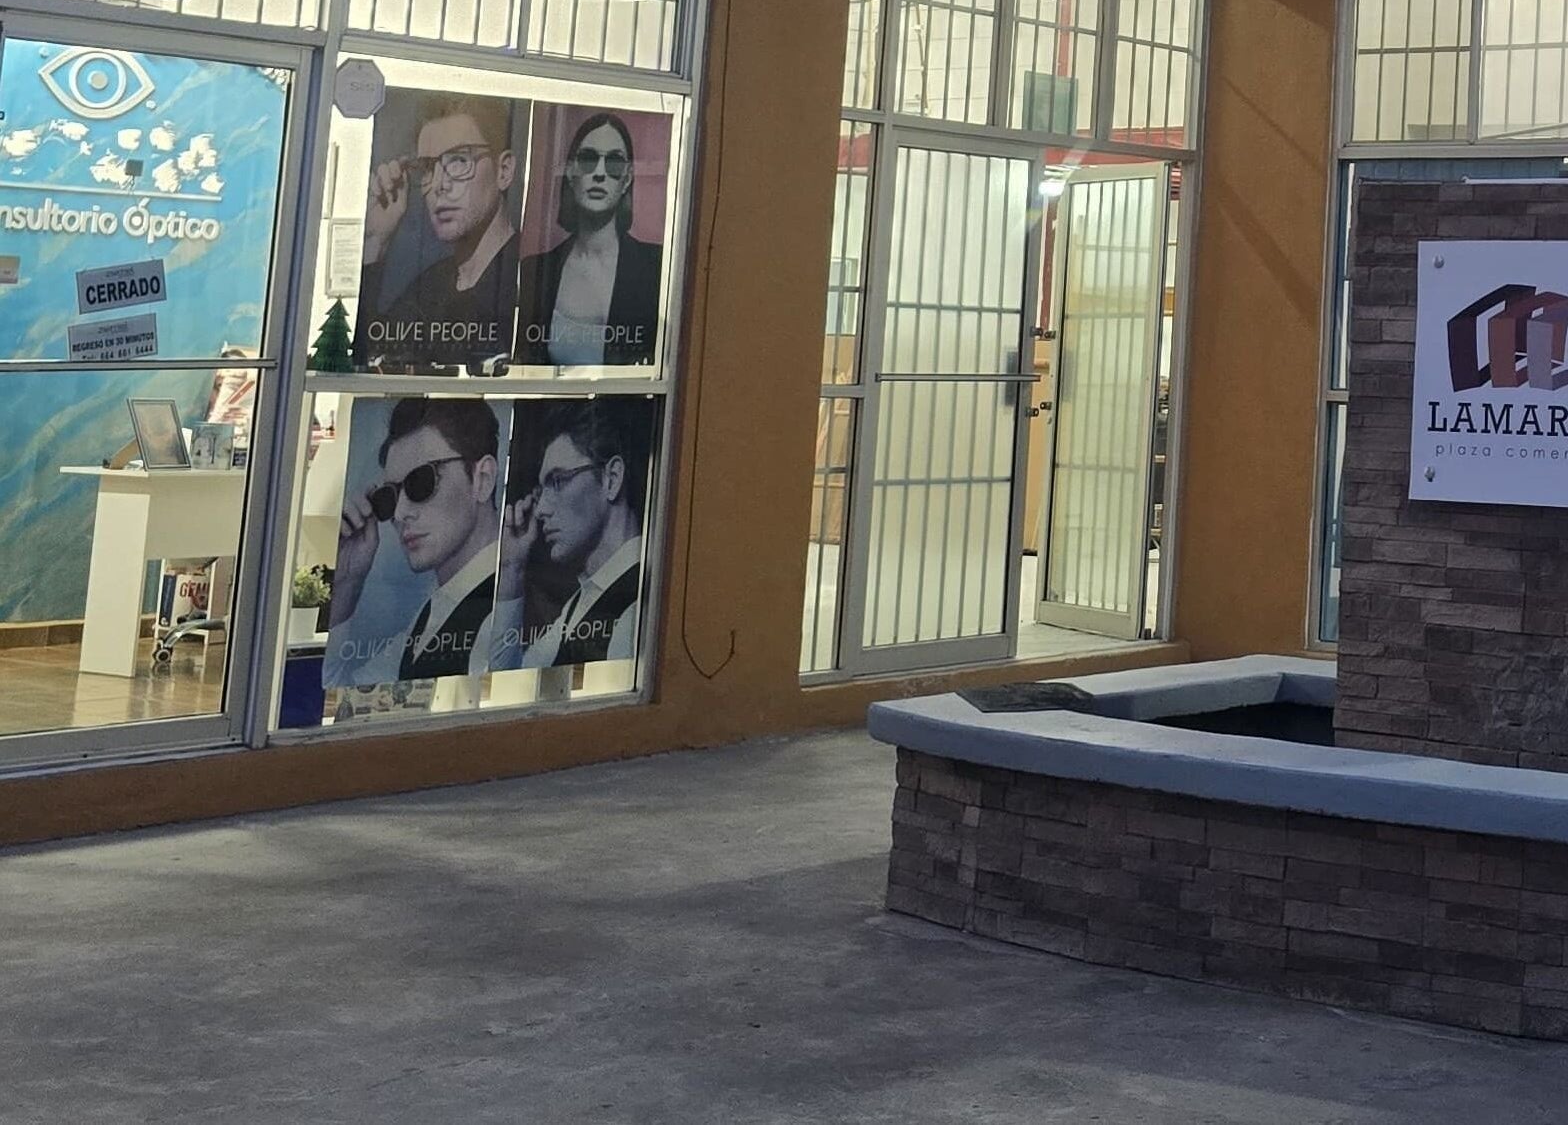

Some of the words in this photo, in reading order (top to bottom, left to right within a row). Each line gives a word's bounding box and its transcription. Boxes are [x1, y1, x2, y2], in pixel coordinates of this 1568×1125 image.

[123, 198, 220, 244] Óptico
[85, 276, 161, 305] CERRADO
[367, 321, 424, 342] OLIVE
[430, 322, 498, 342] PEOPLE
[526, 324, 575, 343] OLIVE
[581, 325, 644, 343] PEOPLE
[1435, 443, 1492, 457] plaza
[339, 637, 395, 662] OLIVE
[402, 630, 473, 656] PEOPLE
[503, 625, 552, 648] OLIVE
[557, 619, 620, 643] PEOPLE
